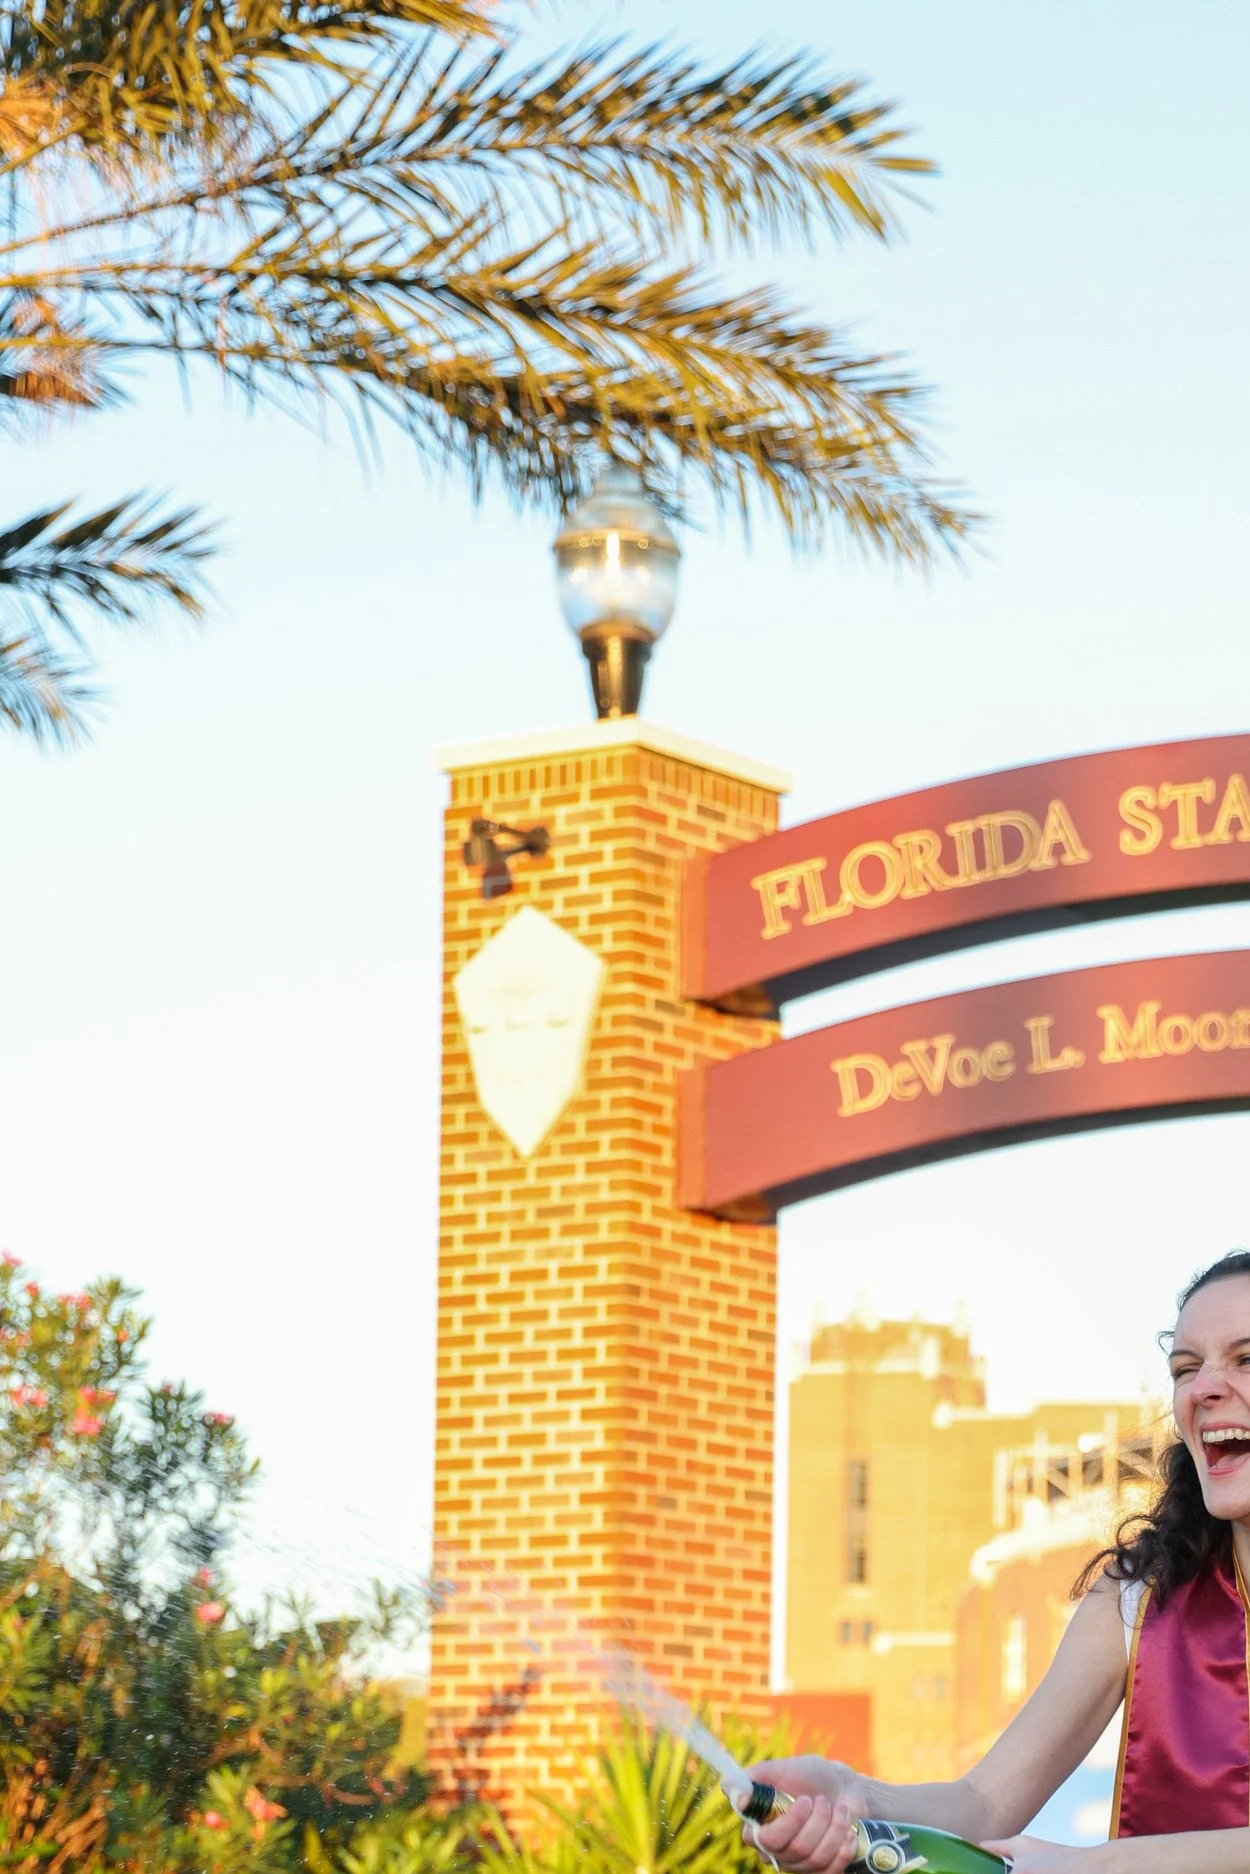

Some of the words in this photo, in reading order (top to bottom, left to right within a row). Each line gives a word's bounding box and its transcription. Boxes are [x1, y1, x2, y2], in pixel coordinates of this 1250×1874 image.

[752, 800, 1091, 940] FLORIDA
[831, 1034, 1015, 1117] DeVoe
[1025, 1016, 1086, 1075] L.
